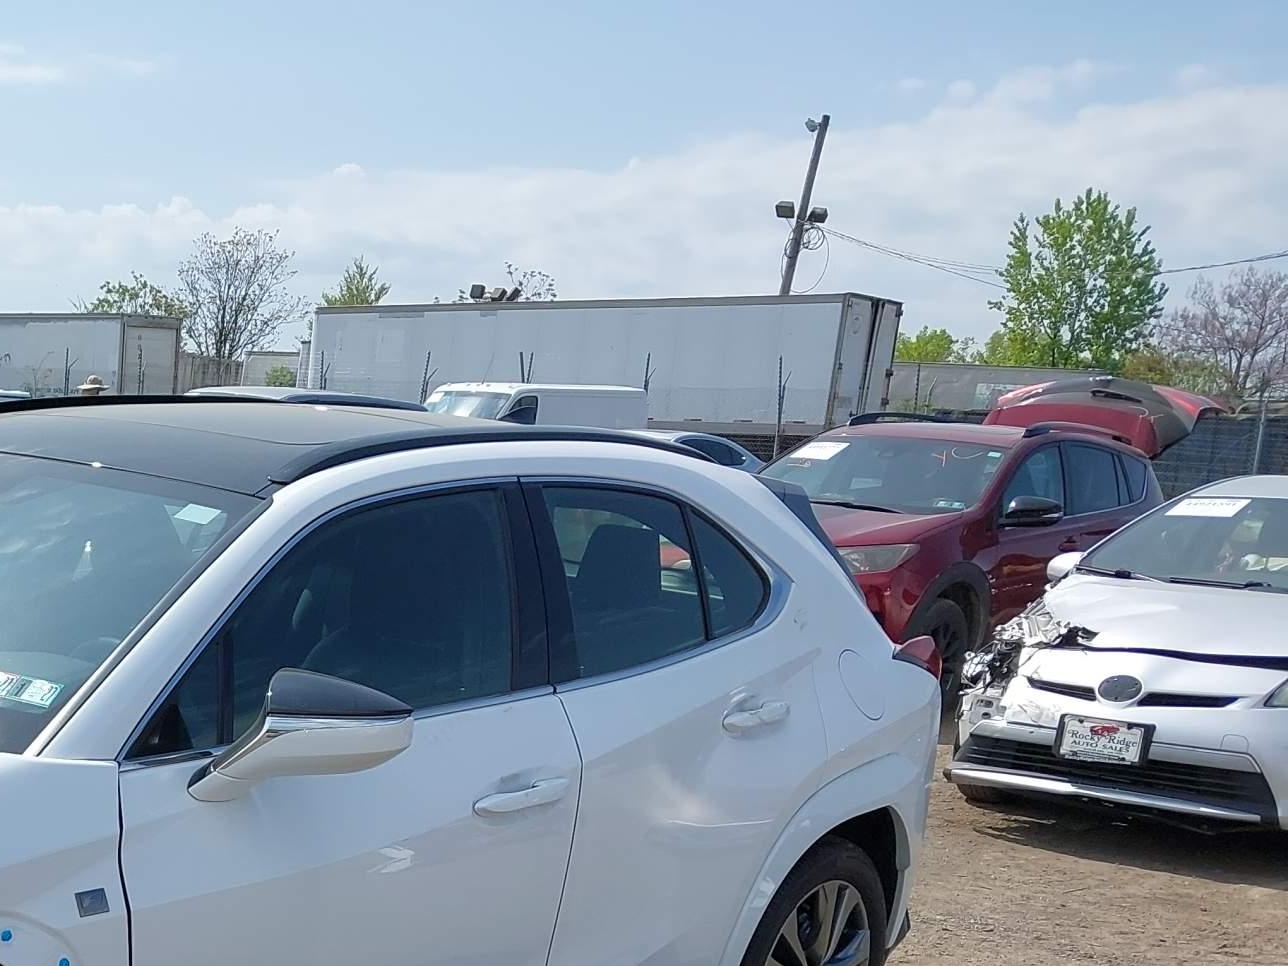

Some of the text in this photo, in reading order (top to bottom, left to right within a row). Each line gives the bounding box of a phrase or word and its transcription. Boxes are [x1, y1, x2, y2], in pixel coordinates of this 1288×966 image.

[1070, 740, 1099, 748] AUTO
[1102, 744, 1130, 753] SALES
[1105, 734, 1138, 748] Ridge
